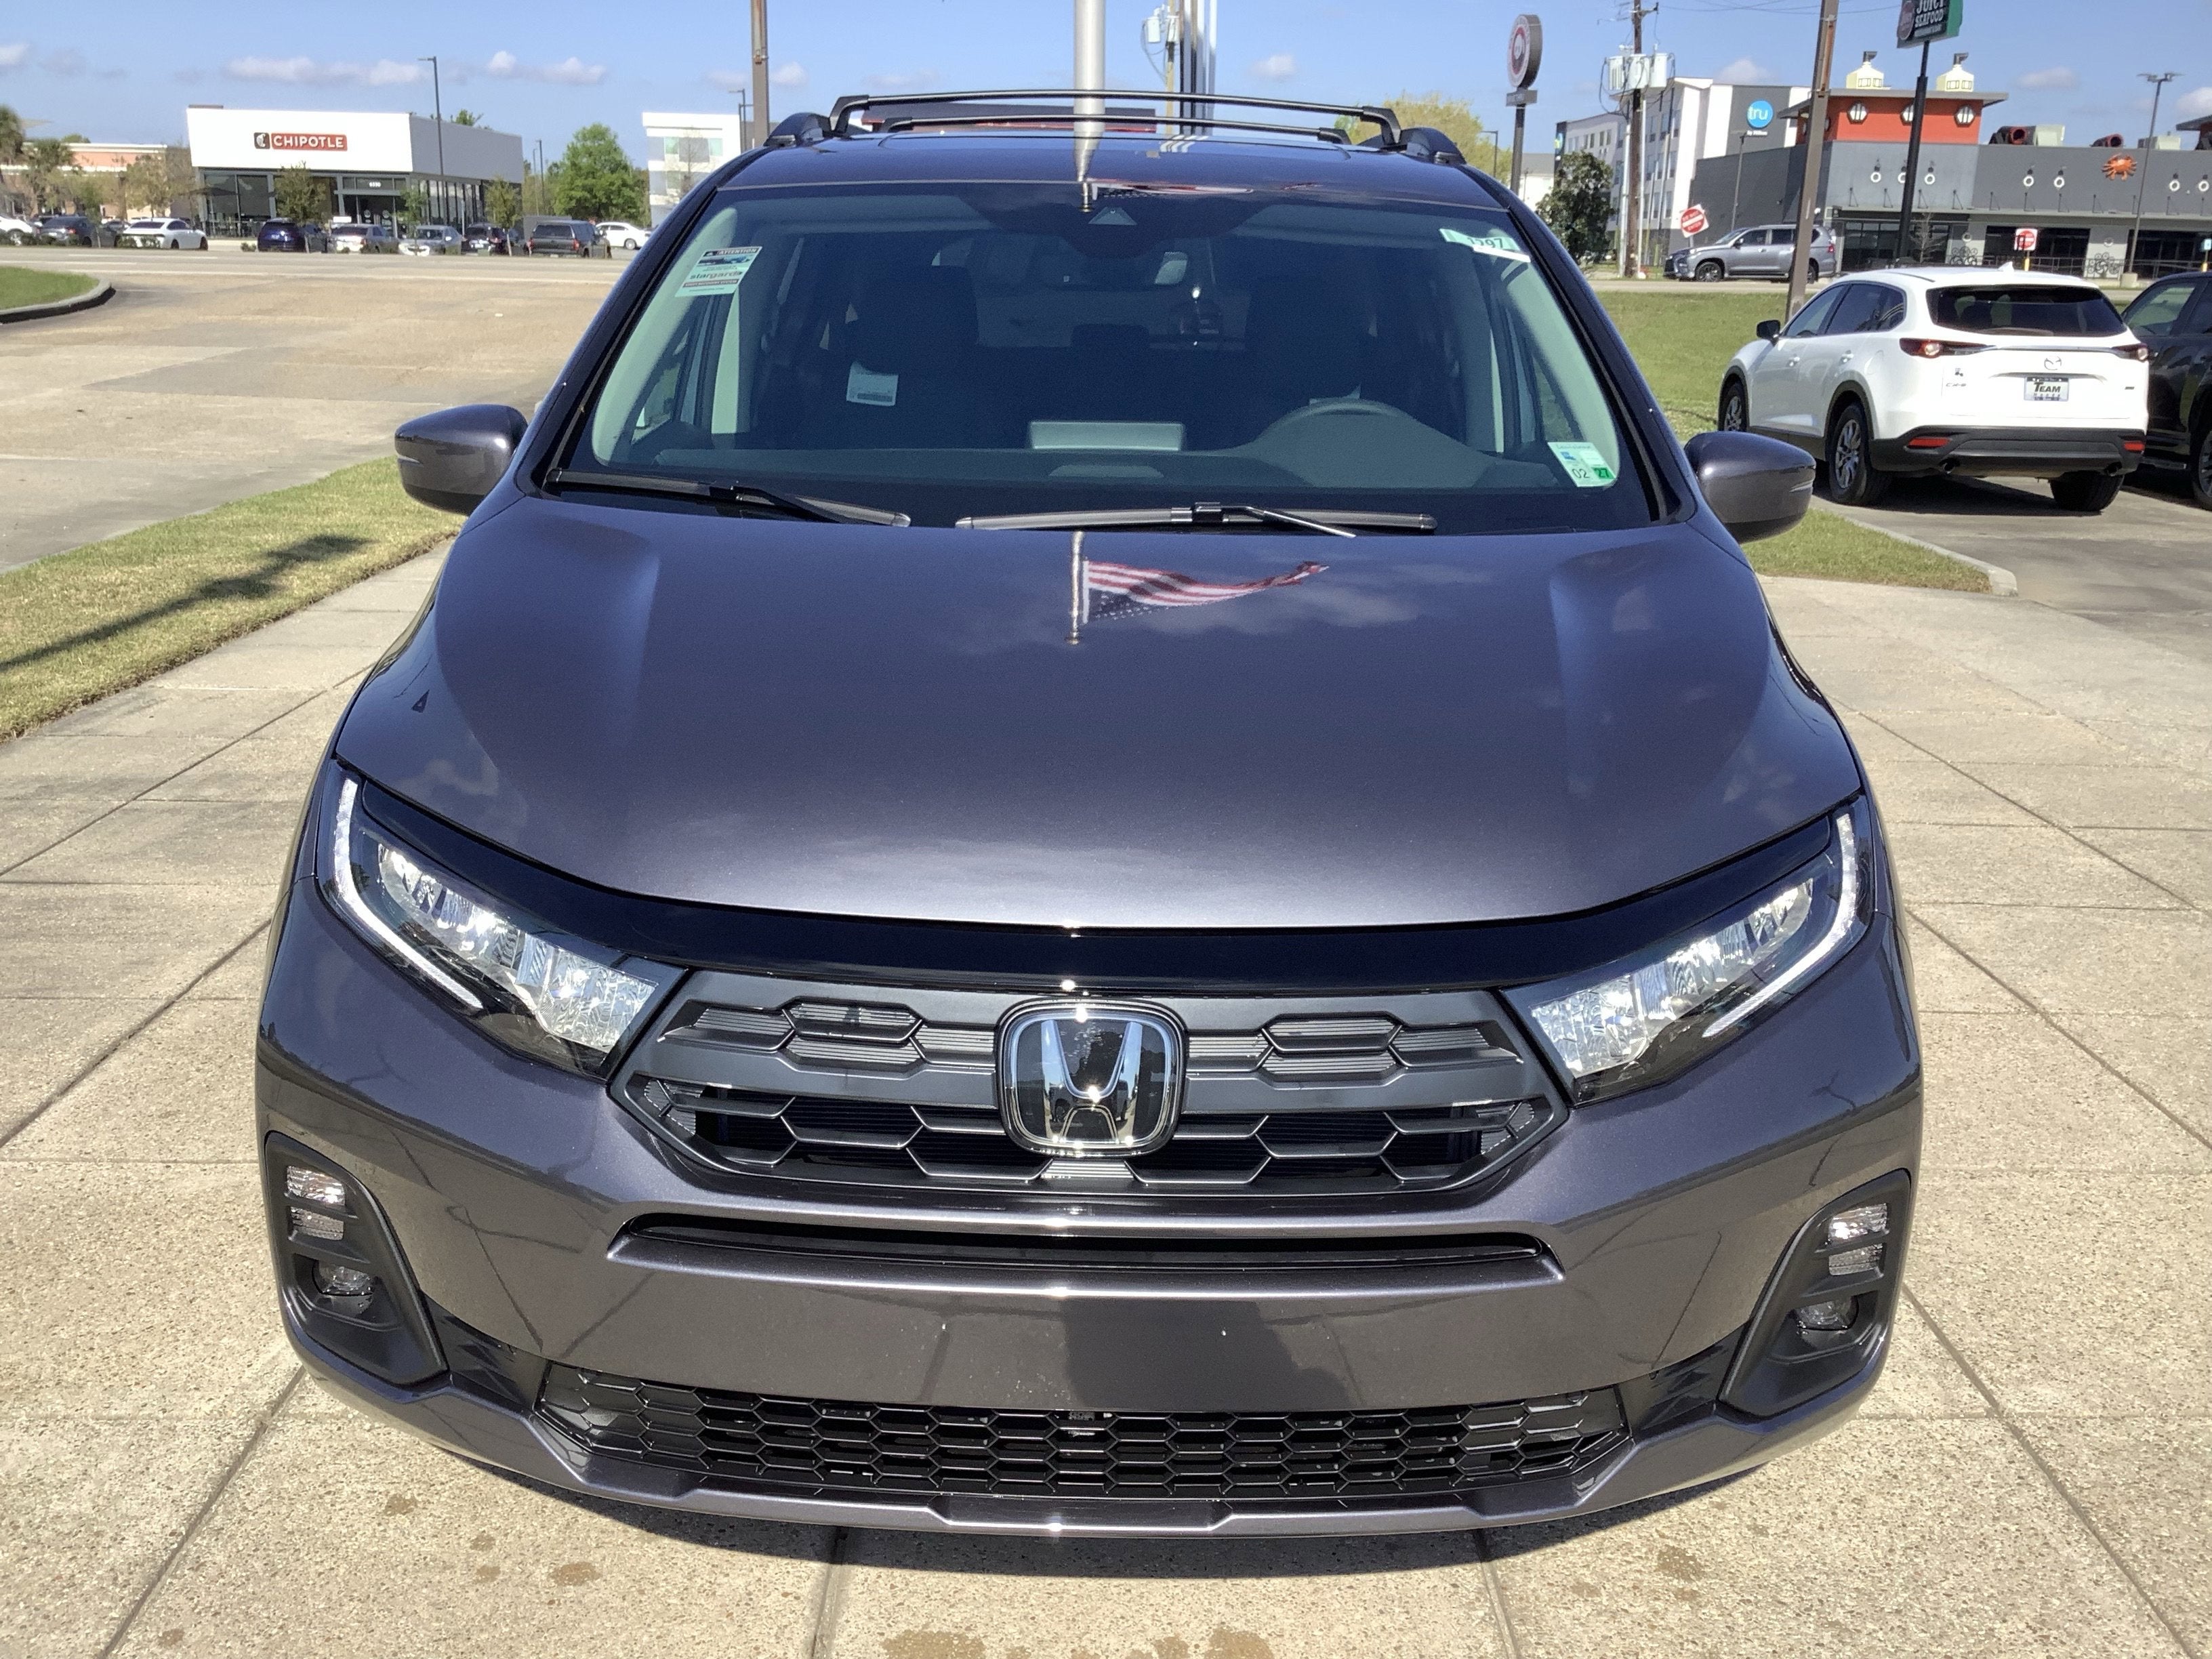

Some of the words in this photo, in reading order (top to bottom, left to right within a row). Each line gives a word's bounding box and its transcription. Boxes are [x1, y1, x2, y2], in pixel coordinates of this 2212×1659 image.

[1748, 105, 1768, 121] tru
[273, 135, 344, 148] CHIPOTLE
[2034, 382, 2061, 392] TEAM
[1572, 468, 1591, 478] 02
[1594, 468, 1610, 478] 27
